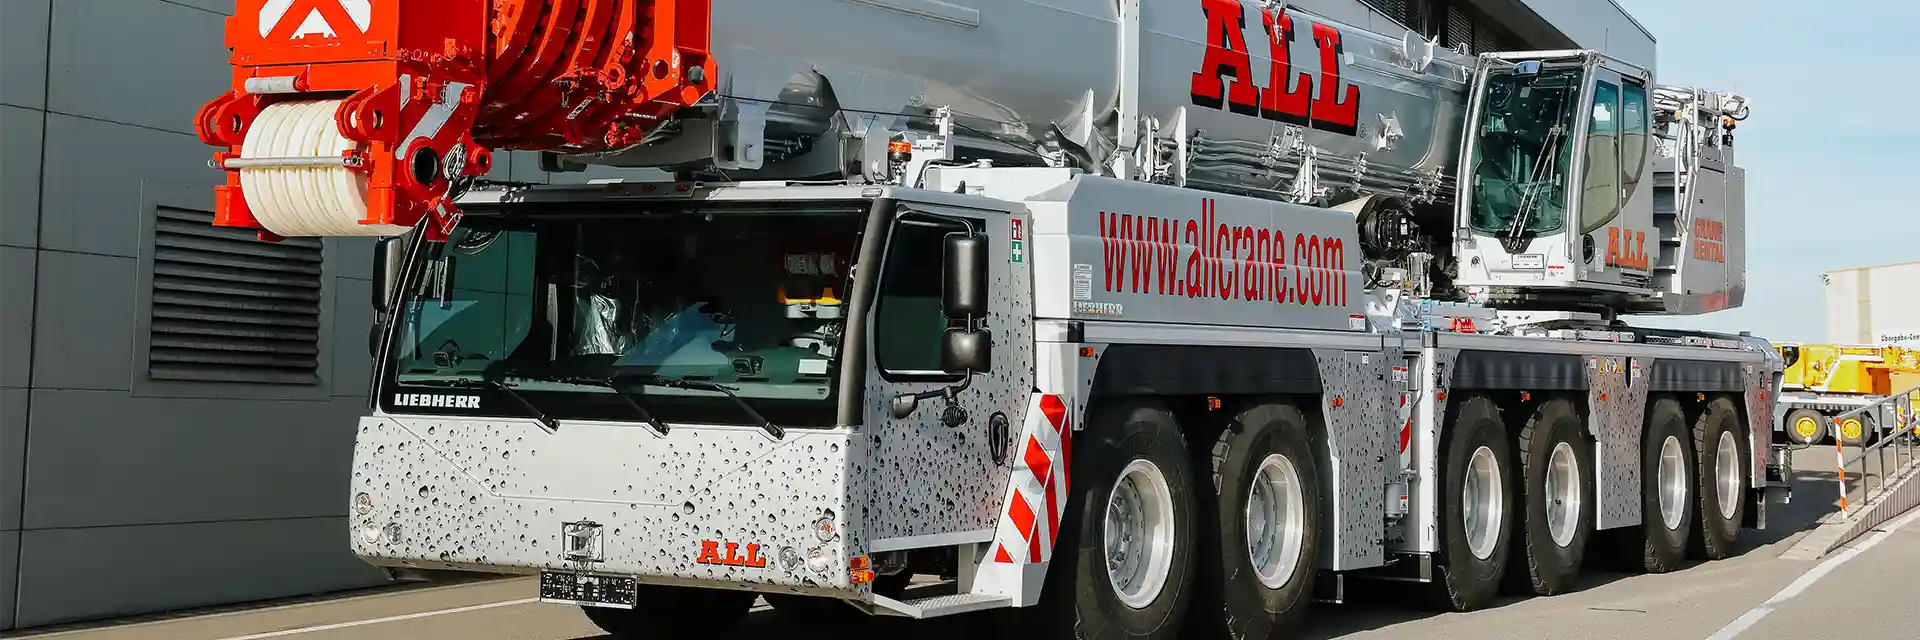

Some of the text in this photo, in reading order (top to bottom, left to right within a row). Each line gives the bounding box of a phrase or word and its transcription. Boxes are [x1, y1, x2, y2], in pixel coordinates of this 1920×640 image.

[1191, 0, 1360, 136] ALL
[1099, 197, 1347, 307] www.allcrane.com
[1605, 227, 1648, 272] ALL
[1693, 240, 1725, 263] RENTAL
[394, 393, 481, 409] LIEBHERR
[697, 540, 766, 568] ALL
